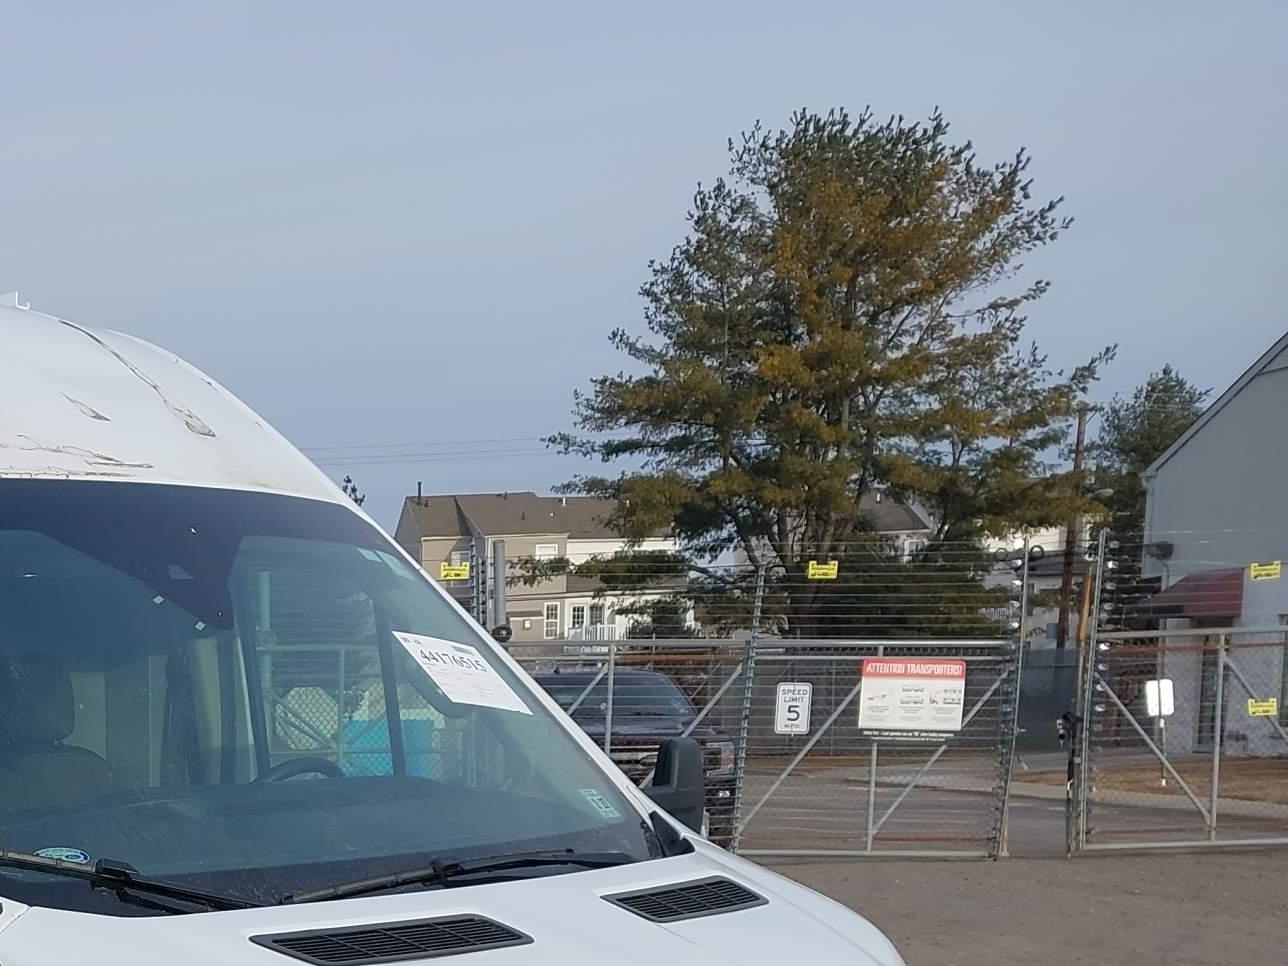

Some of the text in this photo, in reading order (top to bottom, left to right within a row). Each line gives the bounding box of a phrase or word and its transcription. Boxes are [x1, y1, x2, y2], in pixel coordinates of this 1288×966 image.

[419, 649, 488, 673] 44176515
[866, 663, 963, 675] ATTENTION TRANSPORTERS!
[781, 688, 808, 696] SPEED
[787, 705, 800, 721] 5
